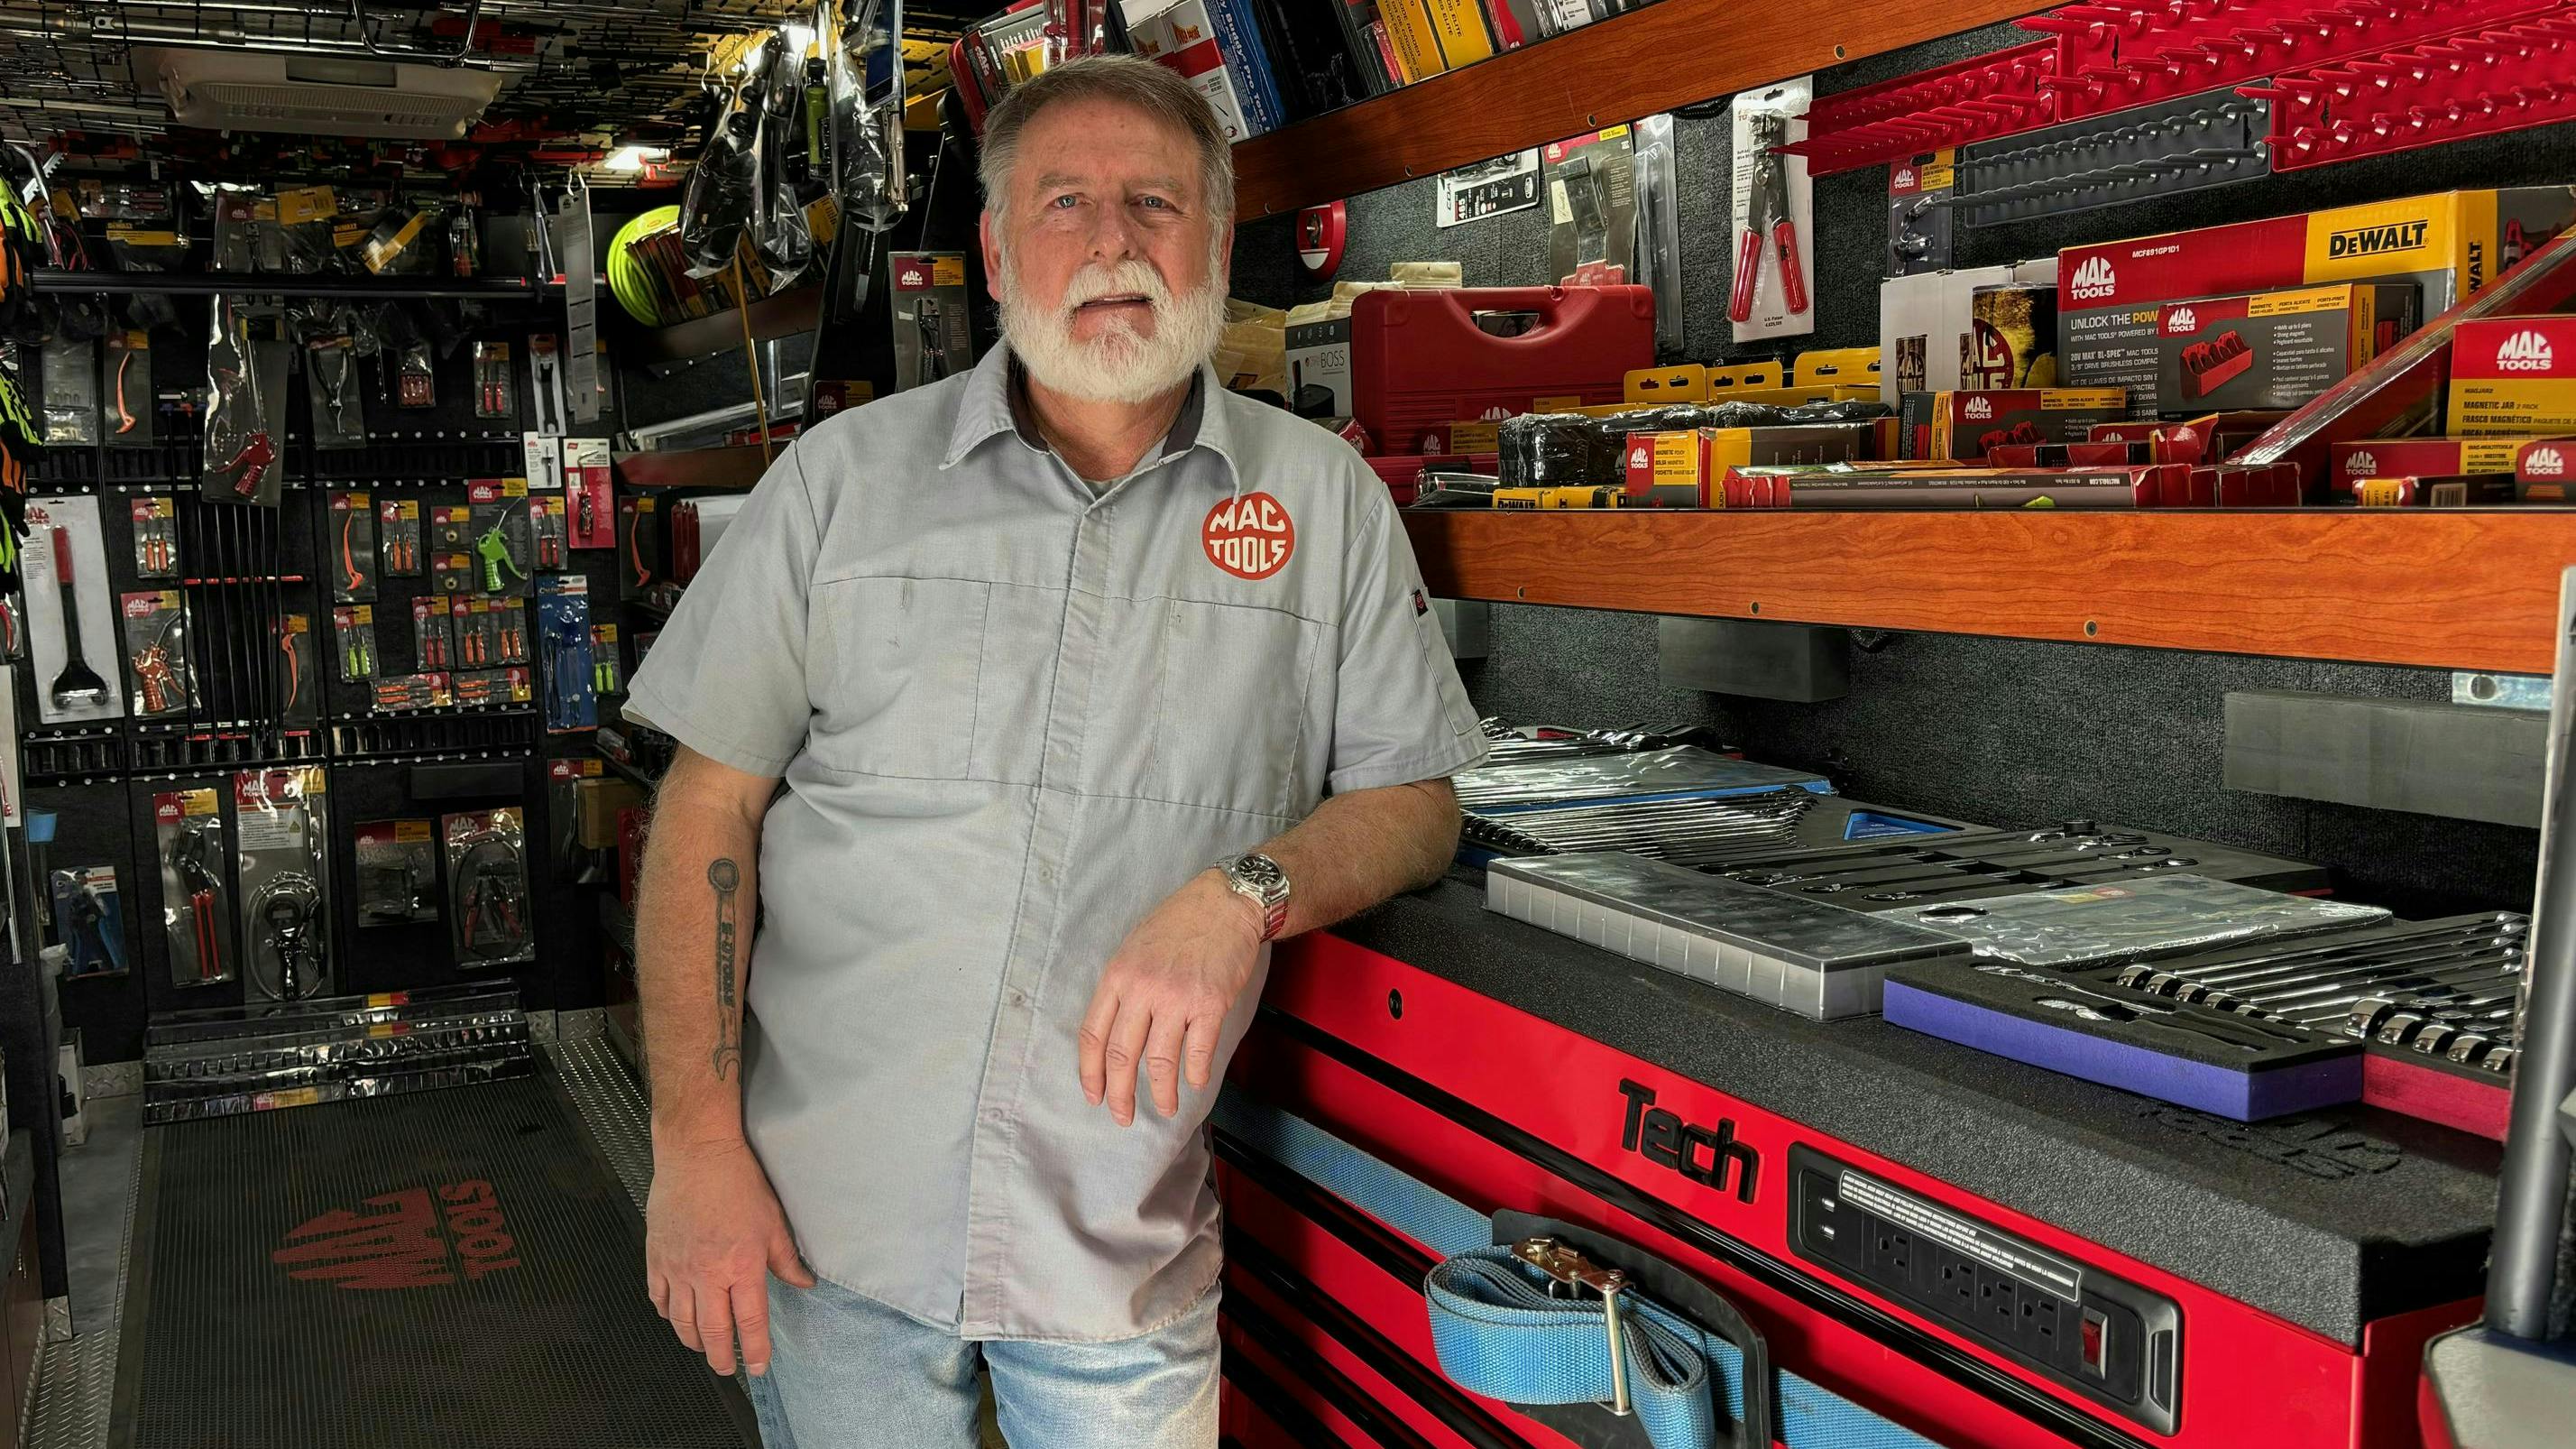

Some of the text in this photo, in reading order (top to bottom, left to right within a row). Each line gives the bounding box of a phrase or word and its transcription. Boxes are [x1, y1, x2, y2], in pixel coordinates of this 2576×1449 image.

[1443, 13, 1453, 35] ELITE
[1451, 14, 1462, 37] ELITE
[1243, 64, 1255, 89] Pro
[1254, 93, 1267, 122] Test
[1895, 170, 1914, 183] MAC
[902, 270, 923, 281] MAC
[2071, 257, 2116, 289] MAC
[2071, 285, 2115, 300] TOOLS
[2071, 315, 2108, 330] UNLOCK
[2111, 313, 2130, 325] THE
[2168, 309, 2195, 326] MAC
[2118, 328, 2146, 338] POWERED
[2168, 324, 2195, 333] TOOLS
[2497, 331, 2553, 360] MAC
[1321, 350, 1344, 368] BOSS
[2101, 360, 2133, 369] BRUSHLESS
[2497, 360, 2553, 371] TOOLS
[1964, 396, 1992, 412] MAC
[1423, 434, 1440, 450] MAC
[1631, 447, 1648, 462] MAC
[2346, 452, 2376, 469] MAC
[2525, 448, 2563, 468] MAC
[1209, 500, 1286, 533] MAC
[1209, 536, 1287, 573] TOOLS
[449, 817, 479, 832] MAC
[1619, 1078, 1759, 1204] Tech
[439, 1179, 520, 1280] TOOLS
